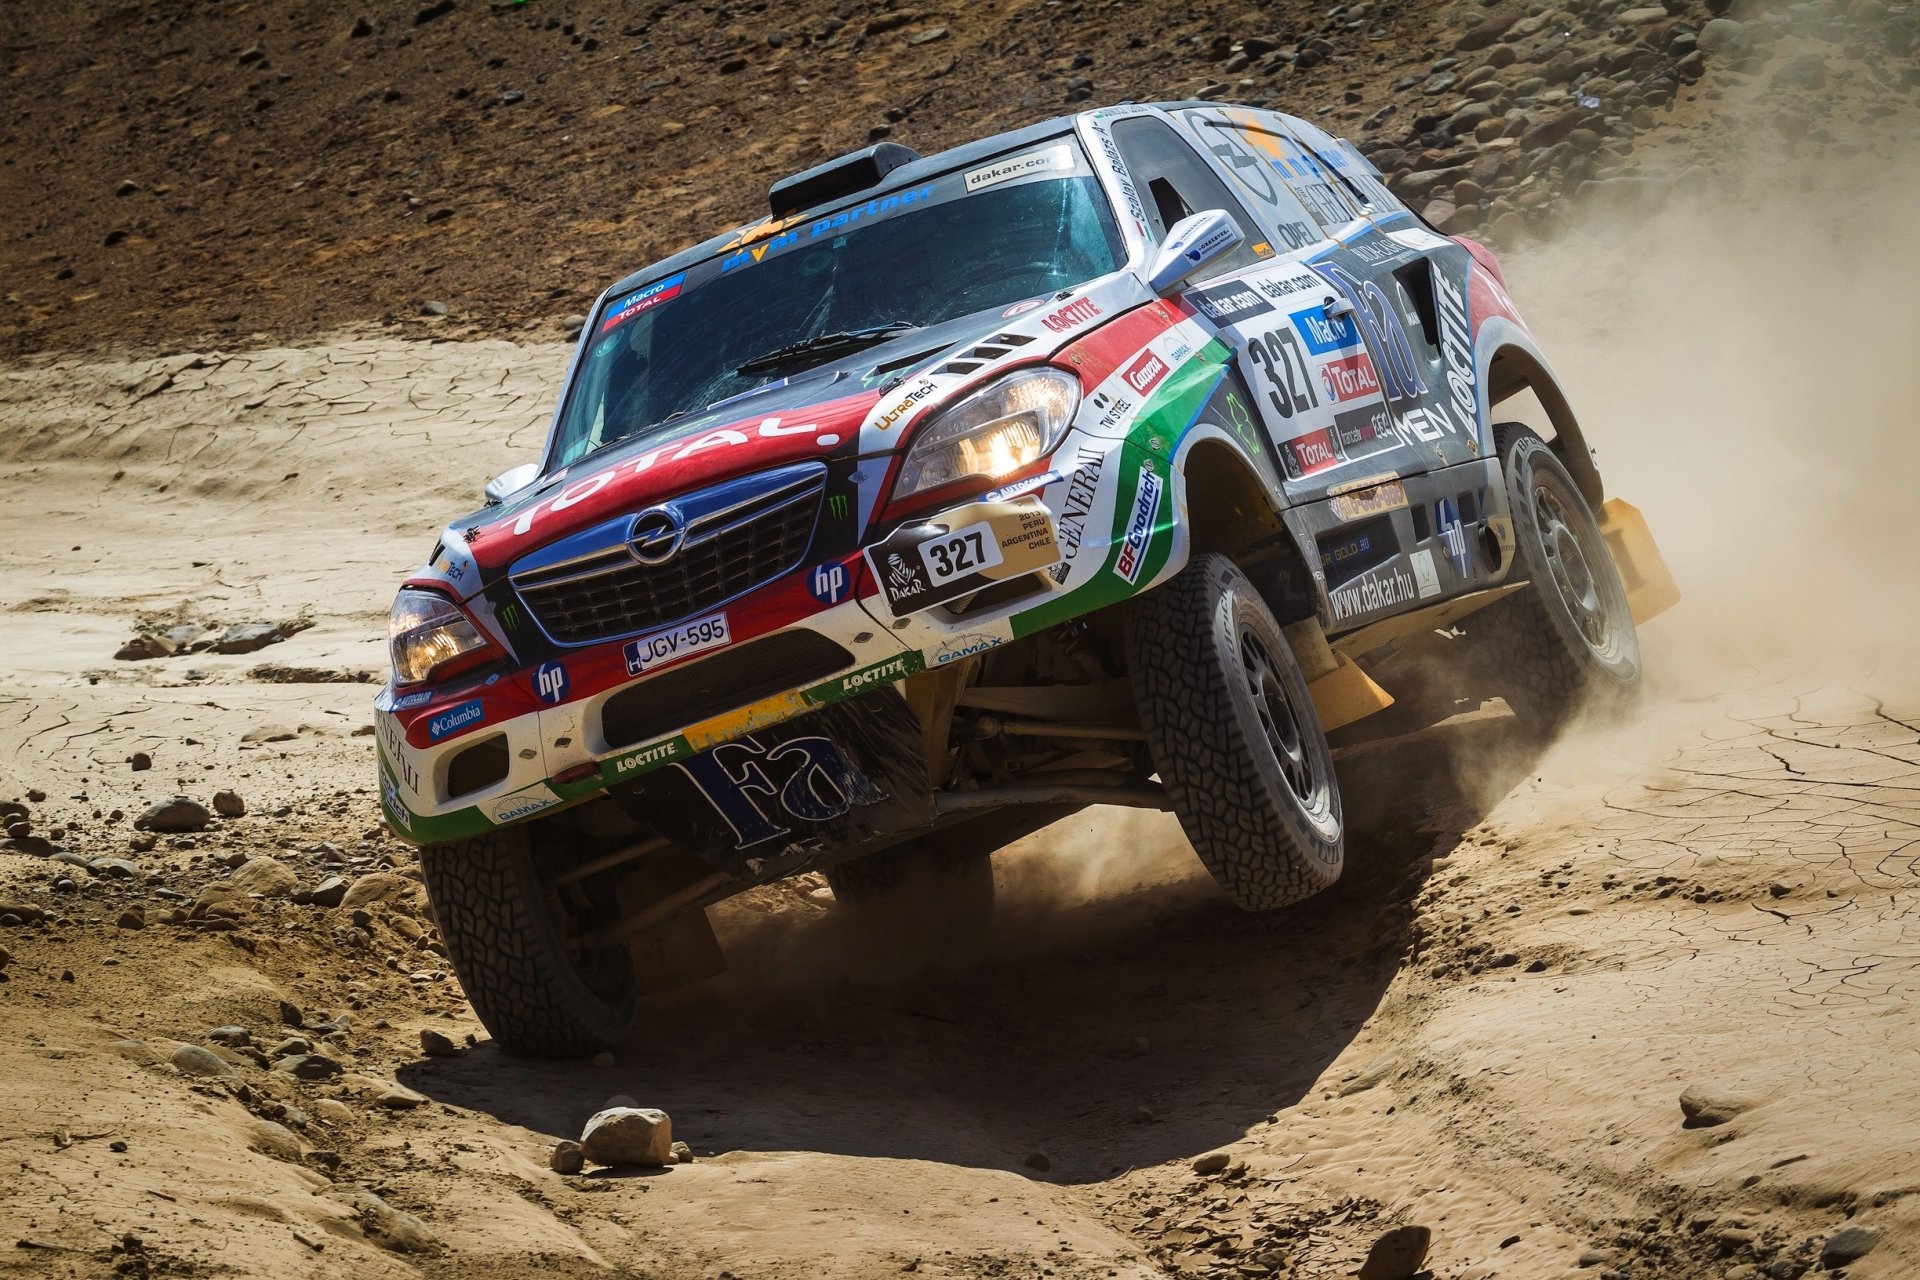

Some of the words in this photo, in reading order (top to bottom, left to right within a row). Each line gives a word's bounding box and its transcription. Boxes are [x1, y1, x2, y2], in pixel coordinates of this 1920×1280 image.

[970, 156, 1050, 184] dakar.co
[811, 184, 938, 241] partner
[1122, 180, 1146, 222] Szalay
[1277, 221, 1321, 250] OPEL
[623, 282, 665, 308] Macro
[1260, 272, 1322, 299] dakar.com
[617, 295, 662, 320] TOTAL
[1041, 295, 1102, 333] LOCTITE
[1200, 289, 1263, 320] dakar.com
[1304, 314, 1348, 345] Macro
[1430, 259, 1479, 440] LOCTITE
[1129, 356, 1163, 391] Carrera
[1247, 326, 1320, 419] 327
[1330, 364, 1377, 396] TOTAL
[1099, 412, 1117, 429] TW
[1109, 398, 1132, 420] STEEL
[1393, 402, 1456, 446] MEN
[1296, 441, 1334, 467] TOTAL
[1018, 510, 1041, 522] 2013
[1058, 445, 1106, 560] GENERALI
[1001, 527, 1049, 549] ARGENTINA
[1022, 518, 1046, 531] PERU
[1117, 471, 1156, 578] BFGoodrich
[929, 530, 986, 579] 327
[1028, 536, 1052, 550] CHILE
[815, 564, 843, 604] hp
[890, 581, 926, 602] DAKAR
[1329, 568, 1415, 621] www.dakar.hu
[640, 618, 726, 665] JGV-595
[938, 636, 1003, 663] GAMAX
[538, 662, 564, 703] hp
[842, 659, 906, 692] LOCTITE
[439, 705, 481, 733] Columbia
[617, 742, 676, 773] LOCTITE
[500, 797, 551, 822] GAMAX
